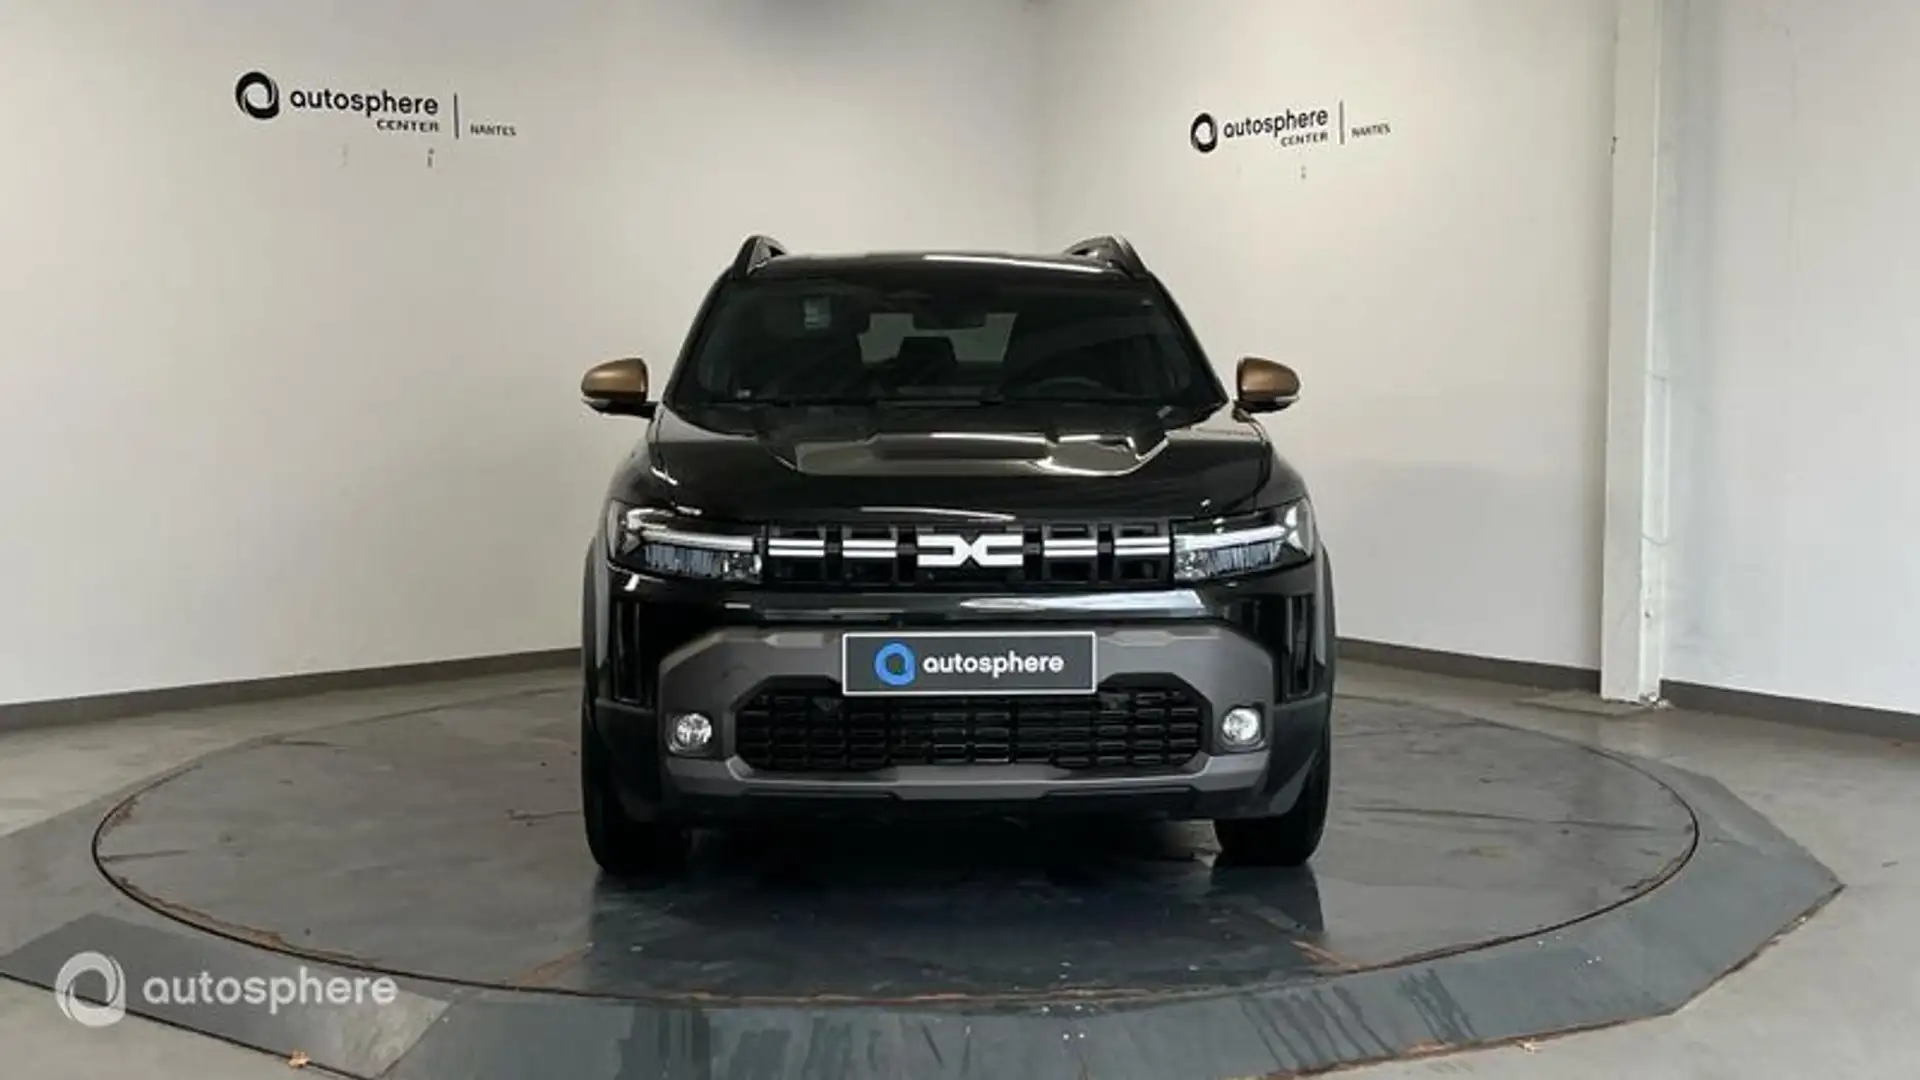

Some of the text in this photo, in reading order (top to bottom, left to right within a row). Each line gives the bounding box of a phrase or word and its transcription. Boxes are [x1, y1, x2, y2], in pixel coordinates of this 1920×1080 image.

[290, 89, 439, 117] autosphere
[376, 119, 440, 133] CENTER
[469, 123, 517, 136] NANTES
[1223, 108, 1329, 137] autosphere
[1351, 122, 1391, 137] NANTES
[1280, 131, 1329, 147] CENTER
[922, 650, 1065, 679] autosphere
